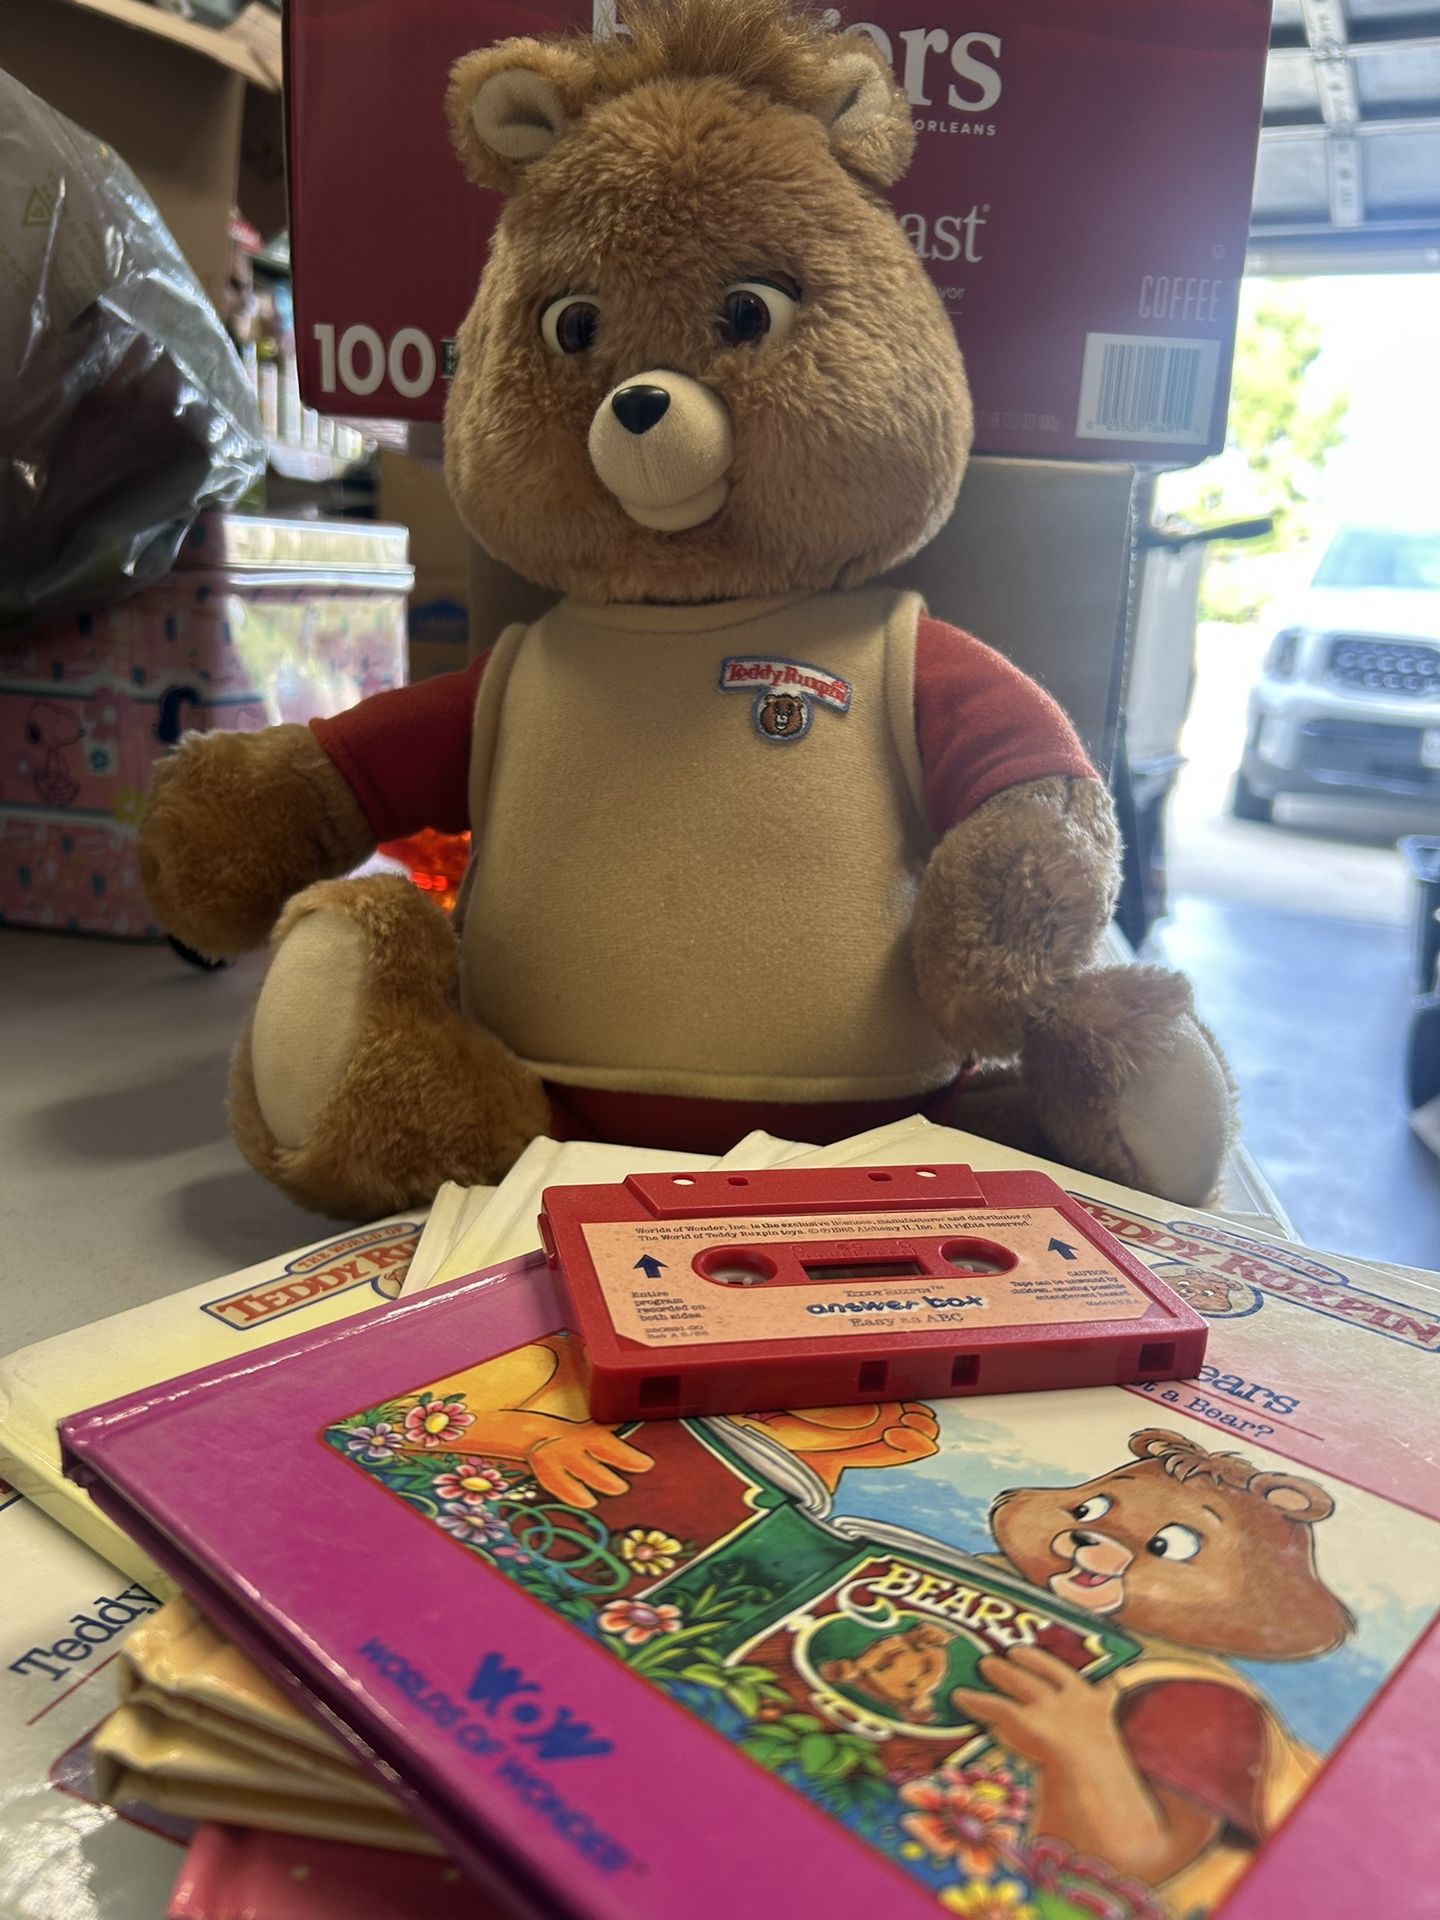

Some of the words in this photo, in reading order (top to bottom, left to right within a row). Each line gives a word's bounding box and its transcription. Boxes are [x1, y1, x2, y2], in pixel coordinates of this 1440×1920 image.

[914, 119, 997, 136] ORLEANS
[1138, 275, 1223, 322] COFFEE
[314, 324, 436, 398] 100
[727, 663, 783, 687] Teddy
[635, 1226, 671, 1234] Worlds
[682, 1224, 727, 1232] Wonder,
[781, 1220, 829, 1228] exclusive
[967, 1213, 1020, 1221] distributor
[660, 1232, 692, 1240] World
[705, 1231, 738, 1240] Teddy
[741, 1230, 780, 1238] Ruxpin
[781, 1229, 806, 1237] toys.
[857, 1225, 901, 1233] Alchemy
[954, 1221, 986, 1230] rights
[297, 1251, 329, 1269] THE
[329, 1231, 382, 1255] WORLD
[1187, 1225, 1226, 1241] THE
[1234, 1235, 1302, 1267] WORLD
[1305, 1265, 1335, 1279] OF
[216, 1260, 370, 1322] TEDDY
[634, 1299, 684, 1307] program
[636, 1305, 689, 1313] recorded
[805, 1298, 920, 1315] answer
[921, 1294, 984, 1309] box
[1212, 1253, 1440, 1343] RUXPIN
[639, 1313, 668, 1321] both
[848, 1317, 896, 1327] Easy
[926, 1312, 964, 1323] ABC
[1196, 1364, 1301, 1415] ears
[1161, 1388, 1179, 1403] a
[1184, 1396, 1275, 1438] Bear?
[866, 1562, 1051, 1646] BEARS
[8, 1582, 165, 1682] Teddy
[359, 1637, 467, 1728] WORLDS
[456, 1723, 505, 1756] OF
[496, 1758, 632, 1877] WONDER
